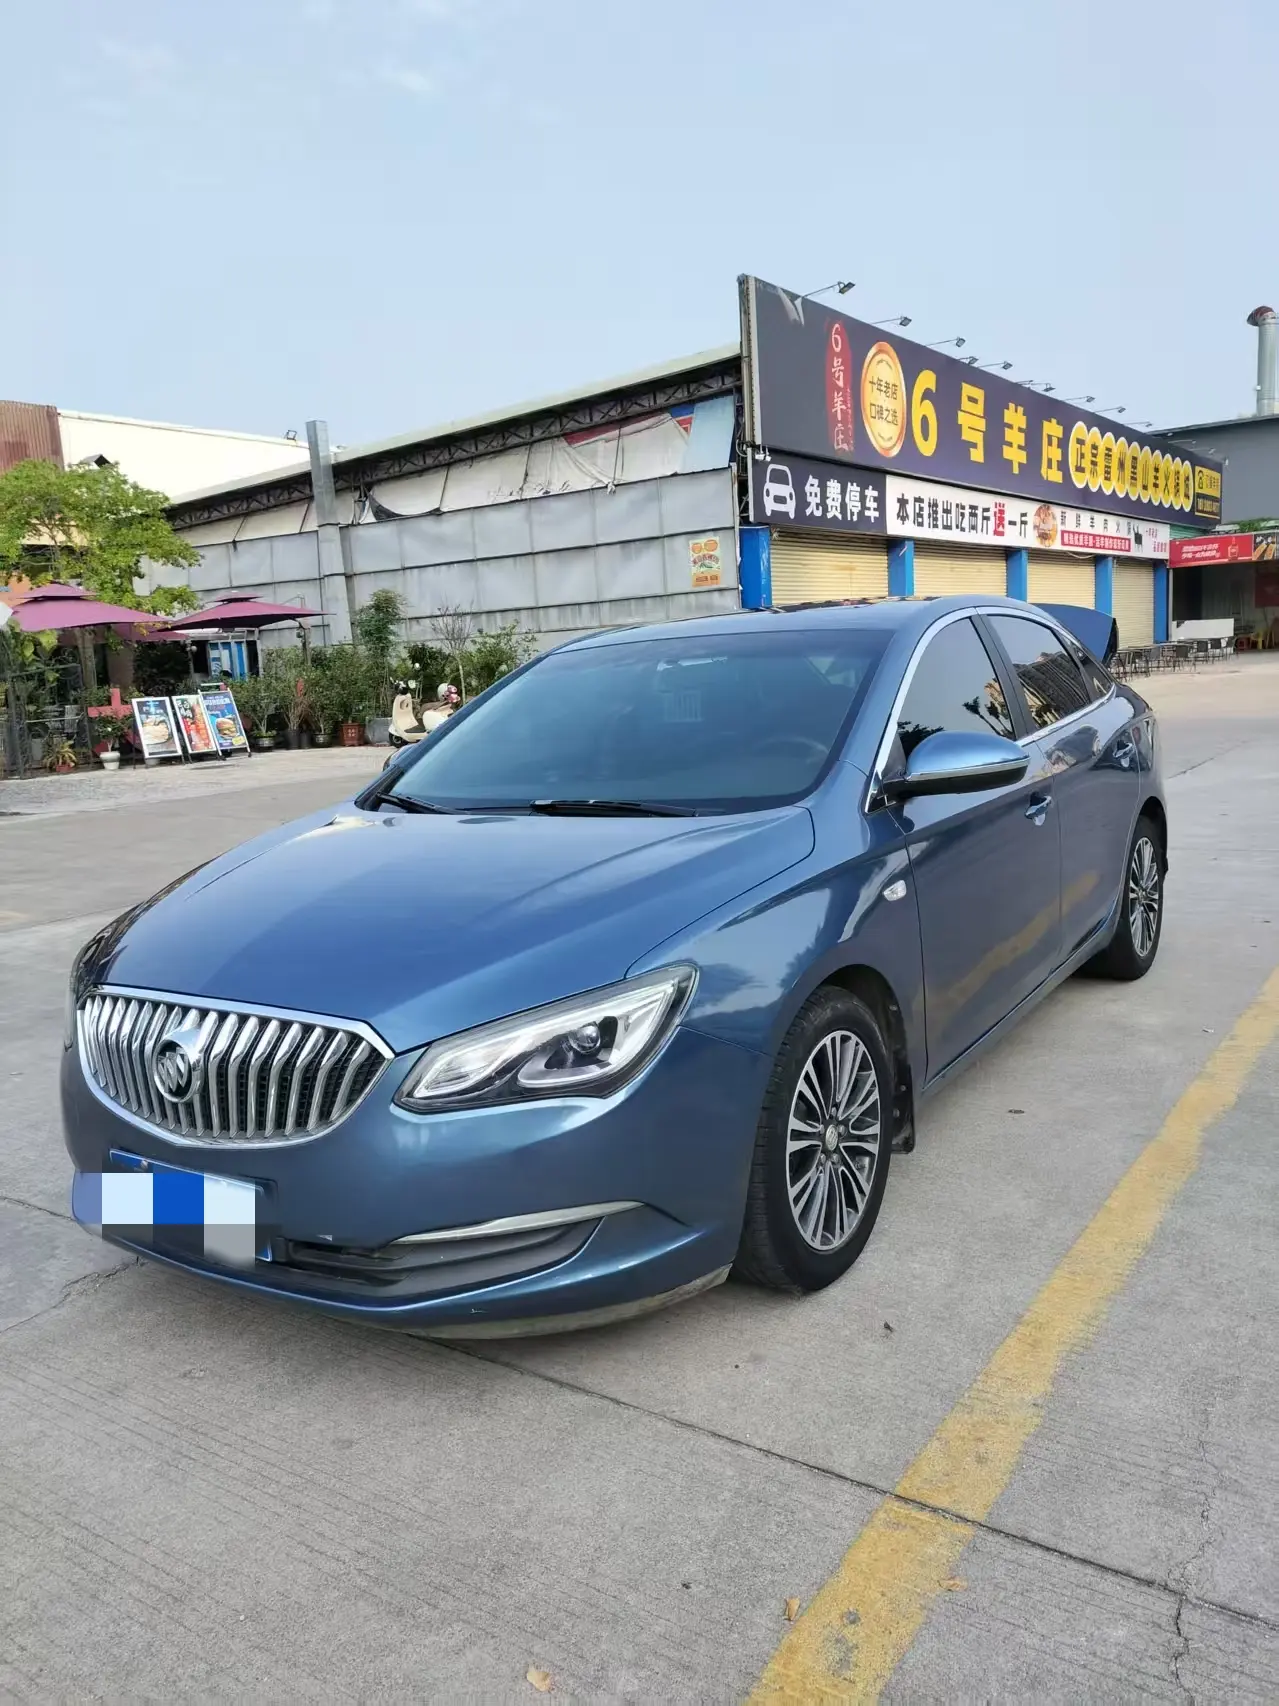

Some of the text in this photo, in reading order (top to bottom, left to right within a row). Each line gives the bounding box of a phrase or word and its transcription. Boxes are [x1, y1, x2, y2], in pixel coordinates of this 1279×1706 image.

[832, 323, 849, 452] 6号羊庄
[868, 376, 899, 400] 十年老店
[869, 402, 899, 426] 口碑之选
[911, 369, 1064, 483] 6号羊庄
[804, 474, 880, 522] 免费停车
[896, 493, 1029, 538] 本店推出吃两斤送一斤
